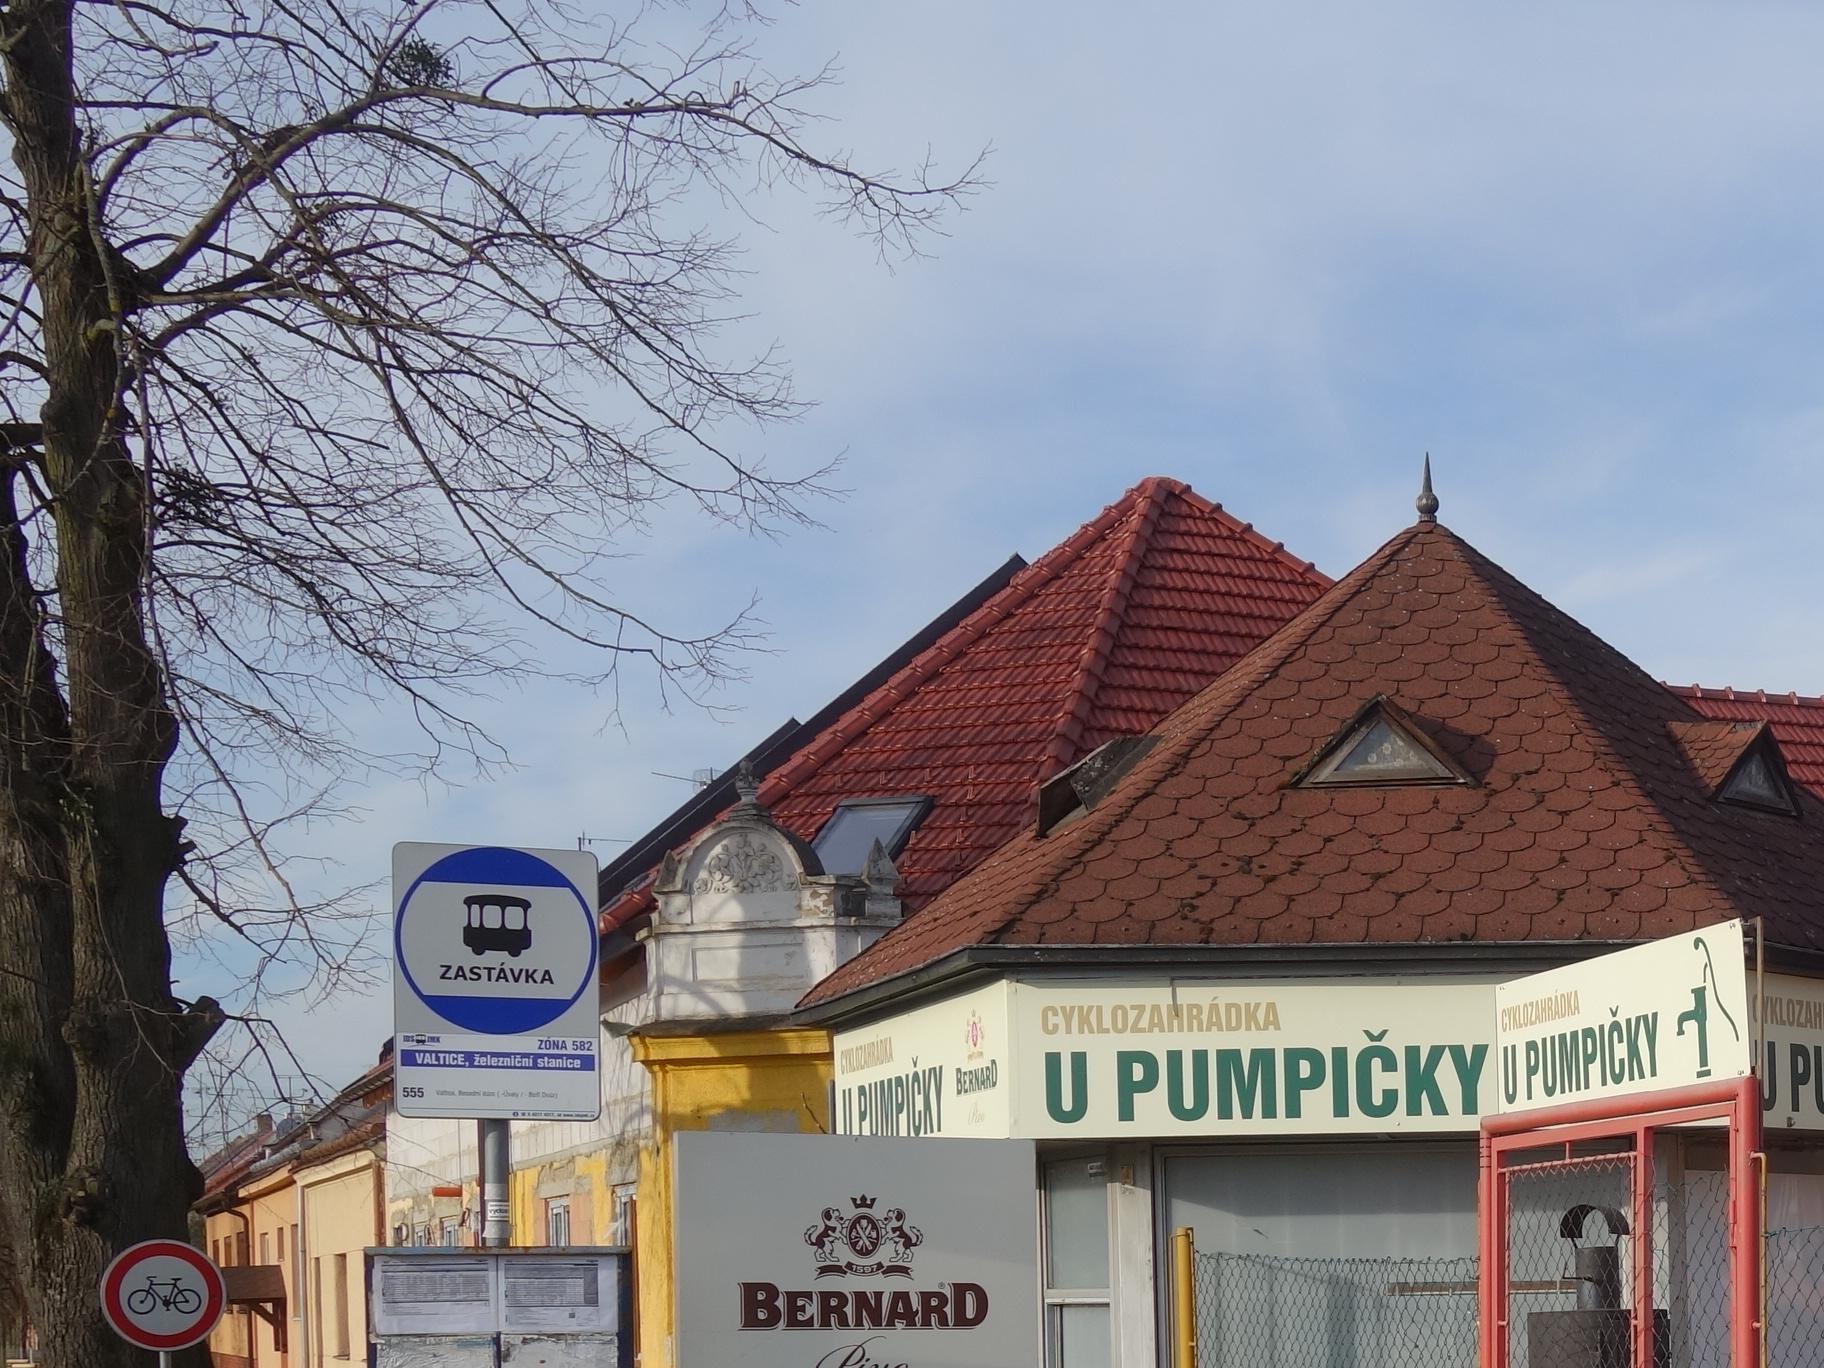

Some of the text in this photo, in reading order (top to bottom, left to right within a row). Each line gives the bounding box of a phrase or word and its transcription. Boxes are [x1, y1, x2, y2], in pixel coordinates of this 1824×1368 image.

[439, 962, 555, 985] ZASTÁVKA
[1041, 996, 1281, 1035] CYKLOZAHRÁDKA
[1502, 989, 1580, 1032] CYKLOZAHRÁDKA
[415, 1052, 581, 1069] VALTICE, železniční stanice
[537, 1036, 593, 1051] ZÓNA 582
[841, 1034, 894, 1075] CYKLOZAHRÁDKA
[1503, 1005, 1658, 1104] U PUMPIČKY
[402, 1087, 424, 1098] 555
[858, 1056, 944, 1136] PUMPIČKY
[955, 1059, 998, 1096] BERNARD
[1045, 1029, 1489, 1124] U PUMPIČKY
[851, 1263, 878, 1275] 1597
[738, 1281, 989, 1331] BERNARD
